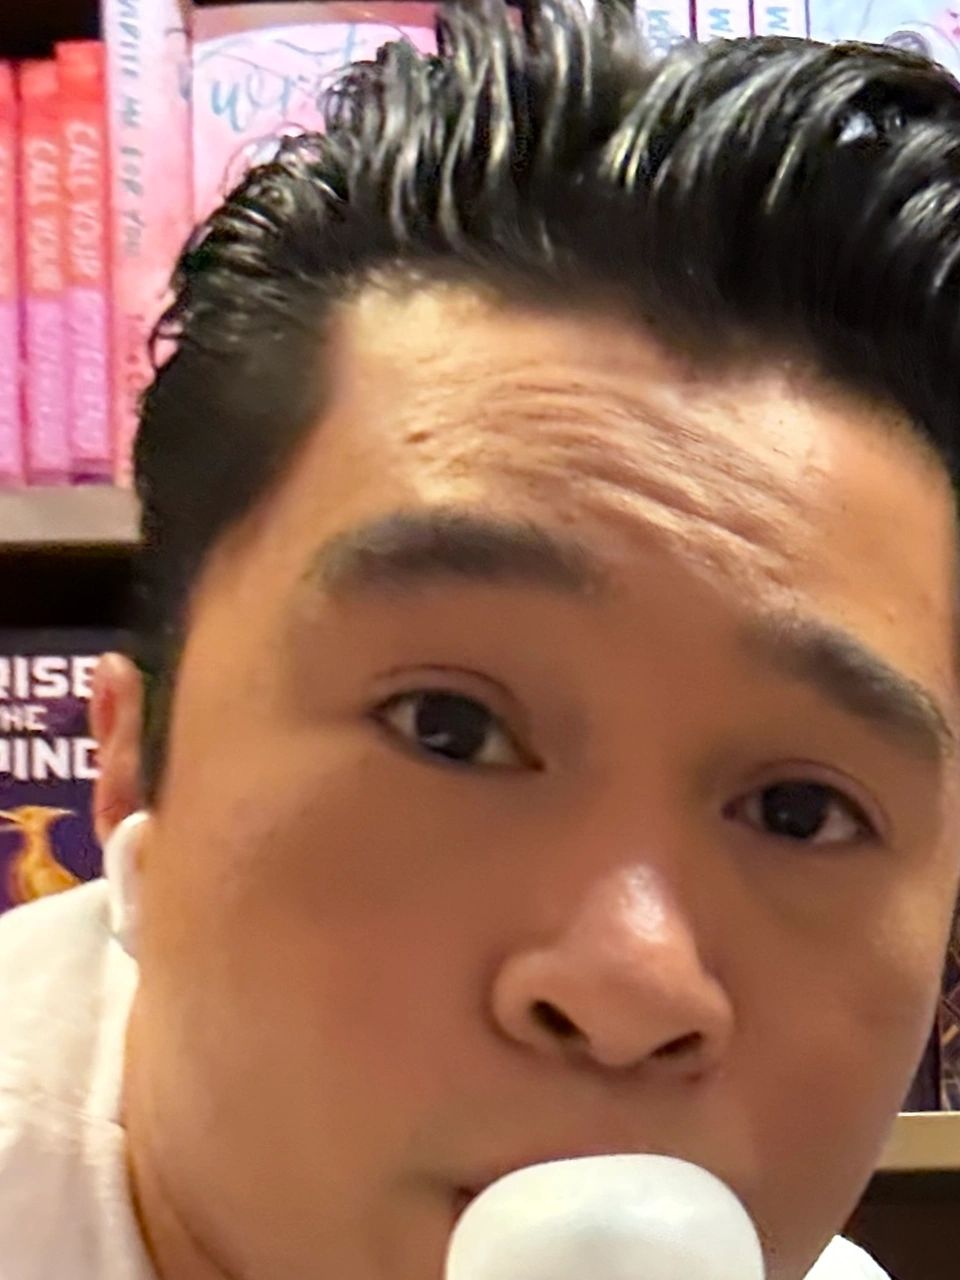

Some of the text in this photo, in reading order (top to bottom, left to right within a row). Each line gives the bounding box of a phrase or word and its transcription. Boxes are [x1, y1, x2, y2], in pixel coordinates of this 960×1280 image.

[63, 119, 99, 191] CALL
[0, 656, 98, 699] ISE
[0, 704, 48, 731] HE
[0, 738, 101, 779] ING
